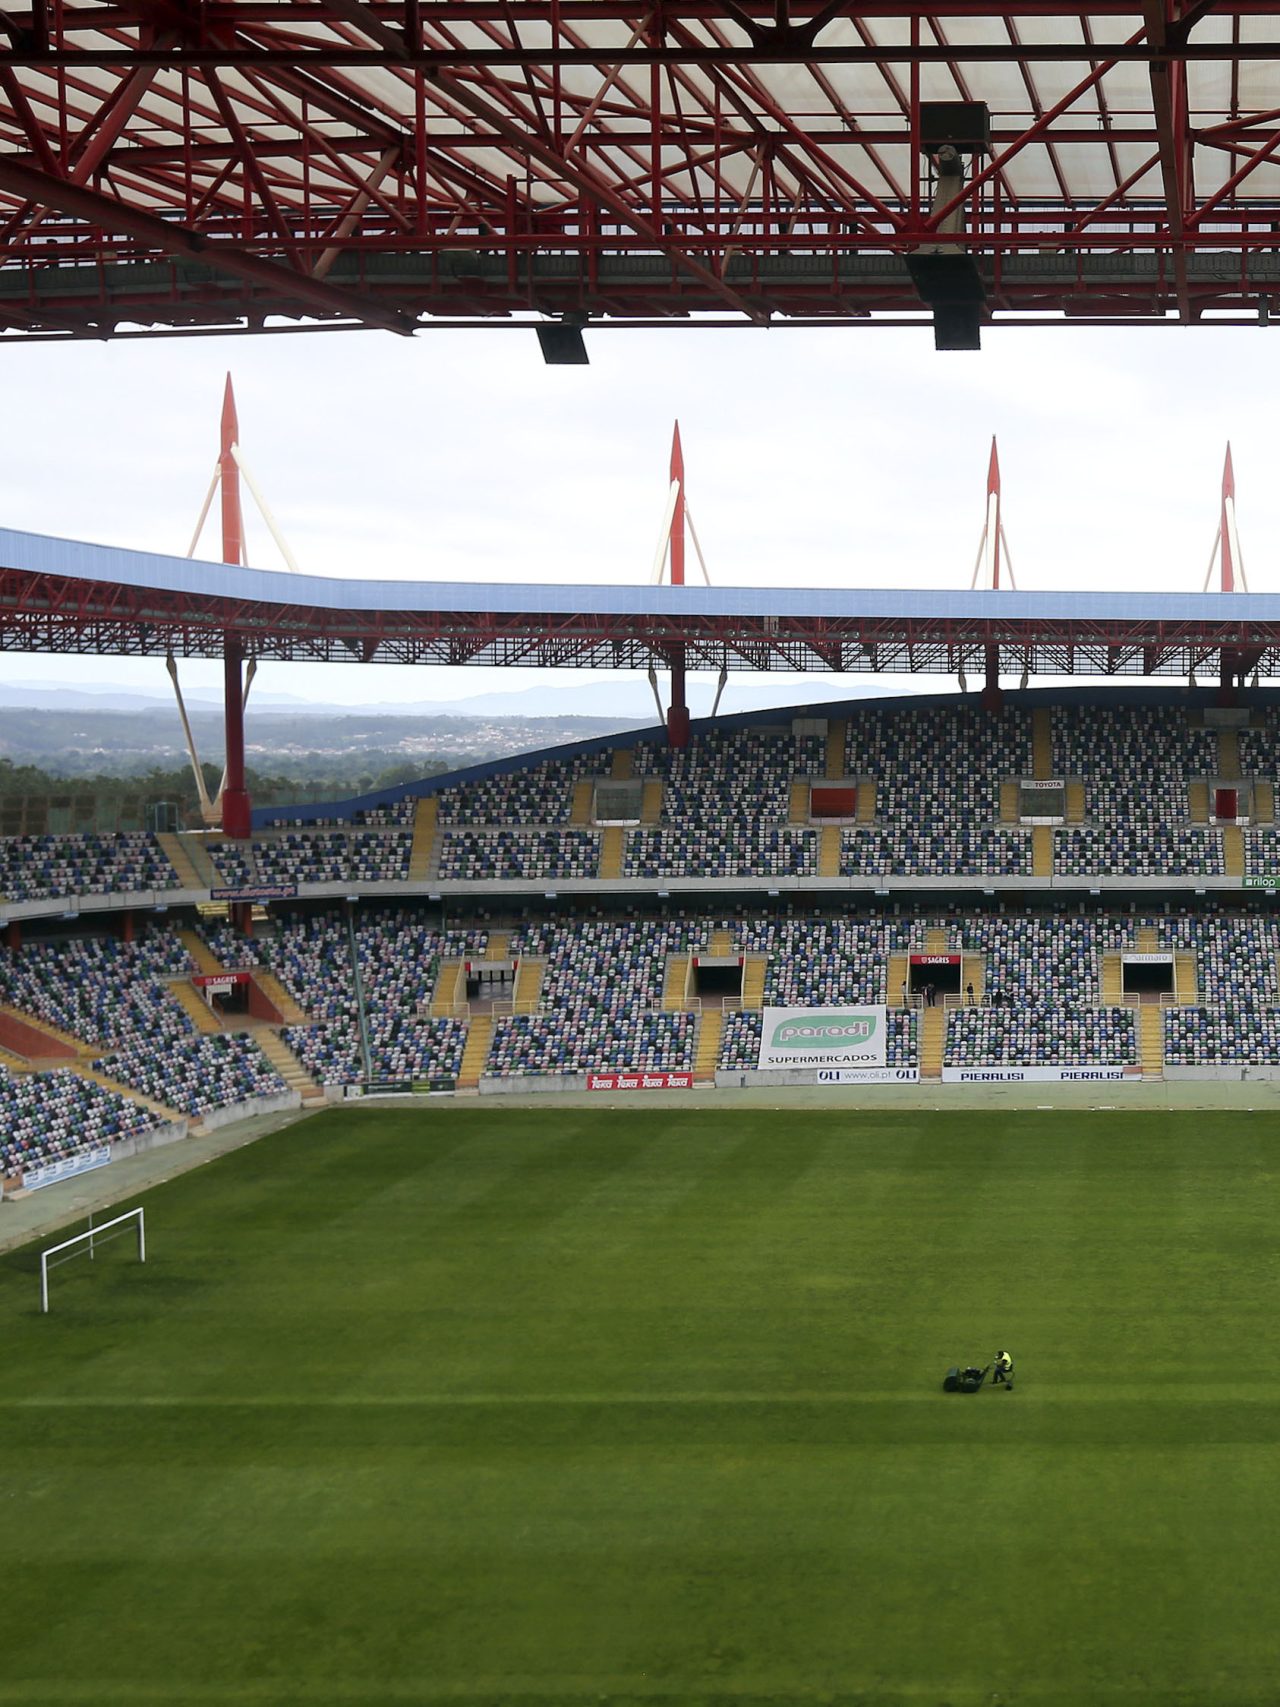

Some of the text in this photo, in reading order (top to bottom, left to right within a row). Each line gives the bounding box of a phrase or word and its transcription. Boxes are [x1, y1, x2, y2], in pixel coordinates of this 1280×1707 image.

[1253, 877, 1276, 887] rilop
[927, 956, 950, 964] SAGRES
[212, 975, 238, 985] SAGRES
[780, 1021, 869, 1041] paradi
[768, 1054, 878, 1064] SUPERMERCADOS
[819, 1070, 917, 1081] OLI www.oli.pt OLI
[961, 1073, 1024, 1081] PIERALISI
